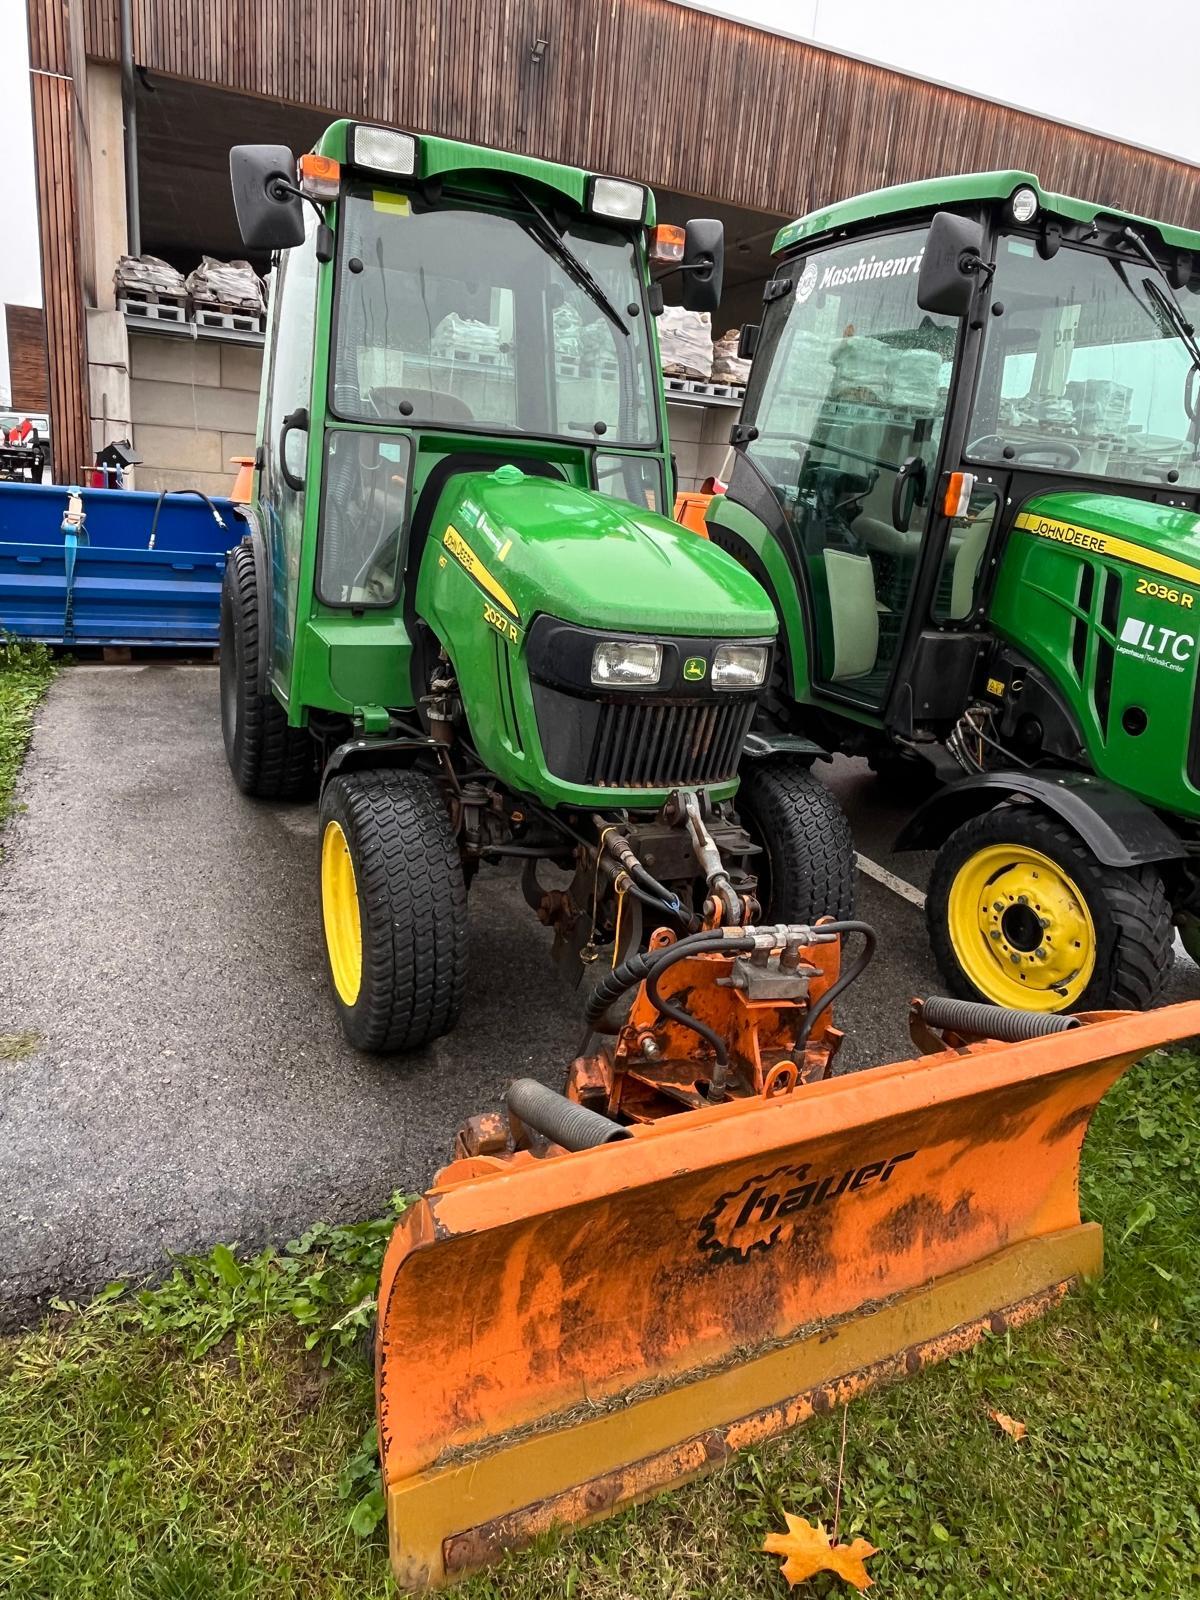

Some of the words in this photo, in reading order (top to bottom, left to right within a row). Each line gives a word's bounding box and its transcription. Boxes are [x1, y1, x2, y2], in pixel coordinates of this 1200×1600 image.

[1033, 519, 1065, 539] JOHN
[1065, 527, 1106, 551] DEERE
[457, 541, 475, 571] DEERE
[1135, 578, 1180, 603] 2036
[1181, 593, 1194, 608] R
[483, 603, 508, 632] 2027
[509, 624, 518, 644] R
[1141, 624, 1195, 661] LTC
[734, 1150, 918, 1228] hauer
